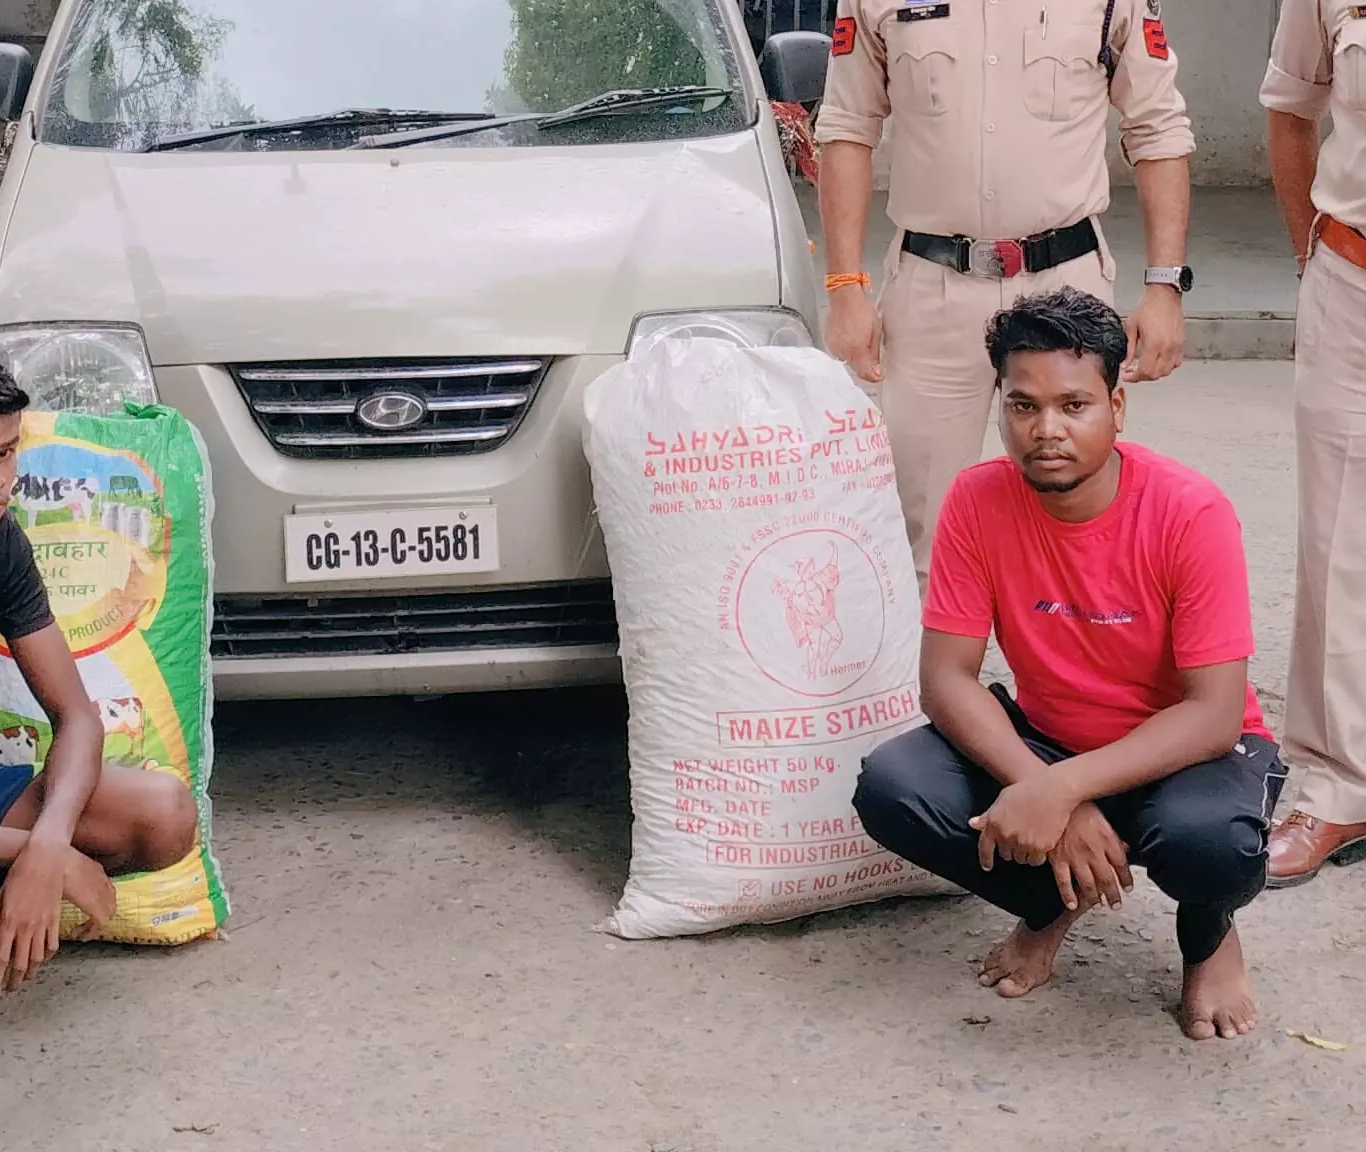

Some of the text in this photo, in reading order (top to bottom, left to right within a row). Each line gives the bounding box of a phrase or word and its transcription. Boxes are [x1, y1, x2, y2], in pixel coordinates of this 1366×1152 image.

[665, 448, 802, 476] INDUSTRIES
[810, 438, 849, 459] PVT.
[306, 523, 481, 570] CG-13-C-5581
[68, 605, 124, 642] PRODUCT
[729, 690, 915, 742] MAIZE STARCH
[673, 759, 701, 773] NET
[709, 758, 779, 773] WEIGHT
[787, 757, 807, 772] 50
[675, 778, 728, 792] BATCH
[781, 777, 820, 793] MSP
[726, 799, 771, 816] DATE
[717, 821, 763, 838] DATE
[798, 817, 844, 838] YEAR
[714, 838, 870, 865] FOR INDUSTRIAL
[771, 879, 807, 897] USE
[813, 874, 837, 891] NO
[844, 858, 904, 885] HOOKS
